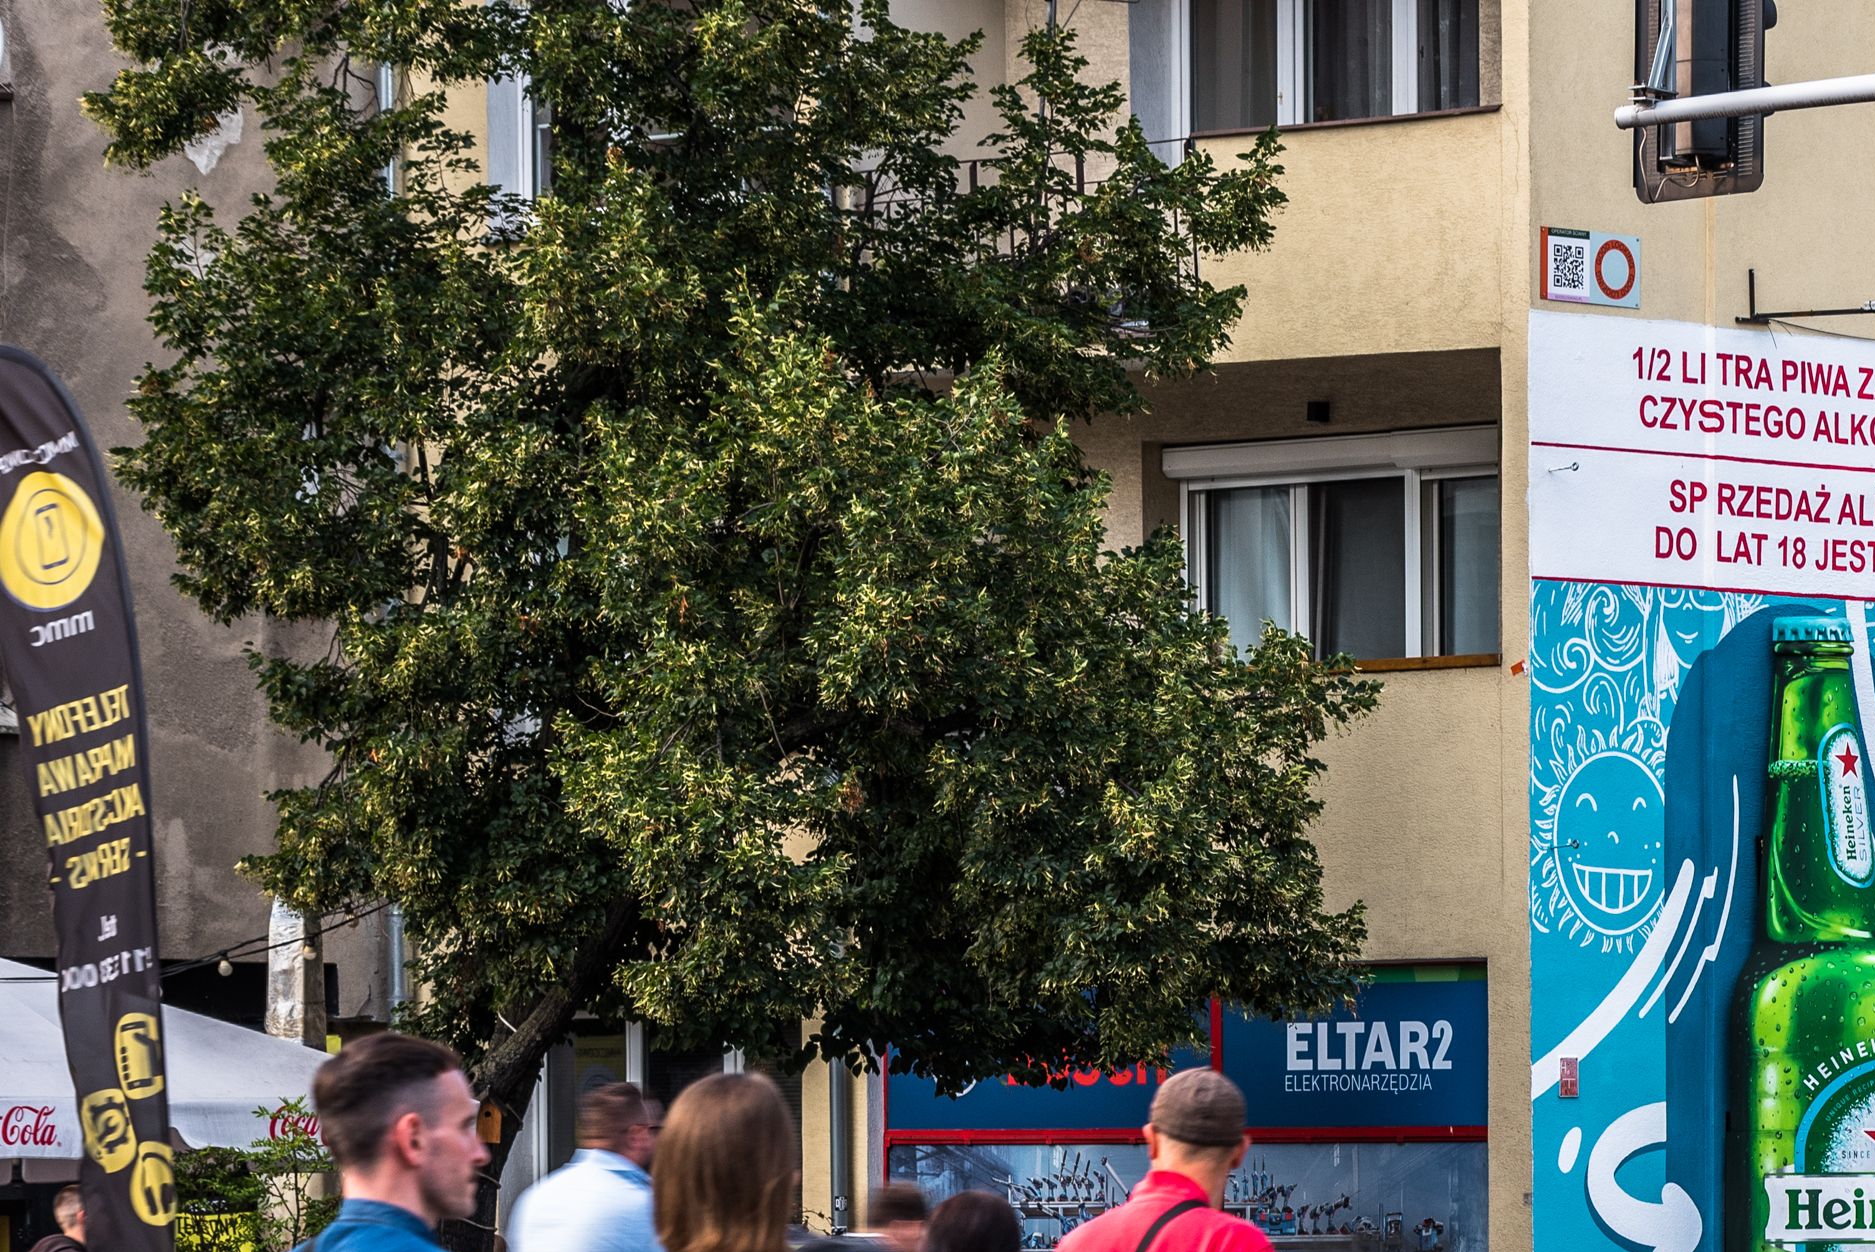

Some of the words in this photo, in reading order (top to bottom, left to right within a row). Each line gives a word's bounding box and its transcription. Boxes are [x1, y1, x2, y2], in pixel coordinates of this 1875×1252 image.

[1632, 347, 1671, 381] 1/2
[1782, 360, 1851, 398] PIWA
[1639, 394, 1806, 440] CZYSTEGO
[1655, 526, 1697, 561] DO
[1716, 530, 1769, 566] LAT
[1777, 535, 1806, 570] 18
[1843, 785, 1857, 861] Heineken
[1853, 785, 1868, 862] SILVER
[1284, 1073, 1433, 1095] ELEKTRONARZĘDZIA
[1825, 1095, 1851, 1122] UNIQUE
[1841, 1150, 1871, 1159] SINCE
